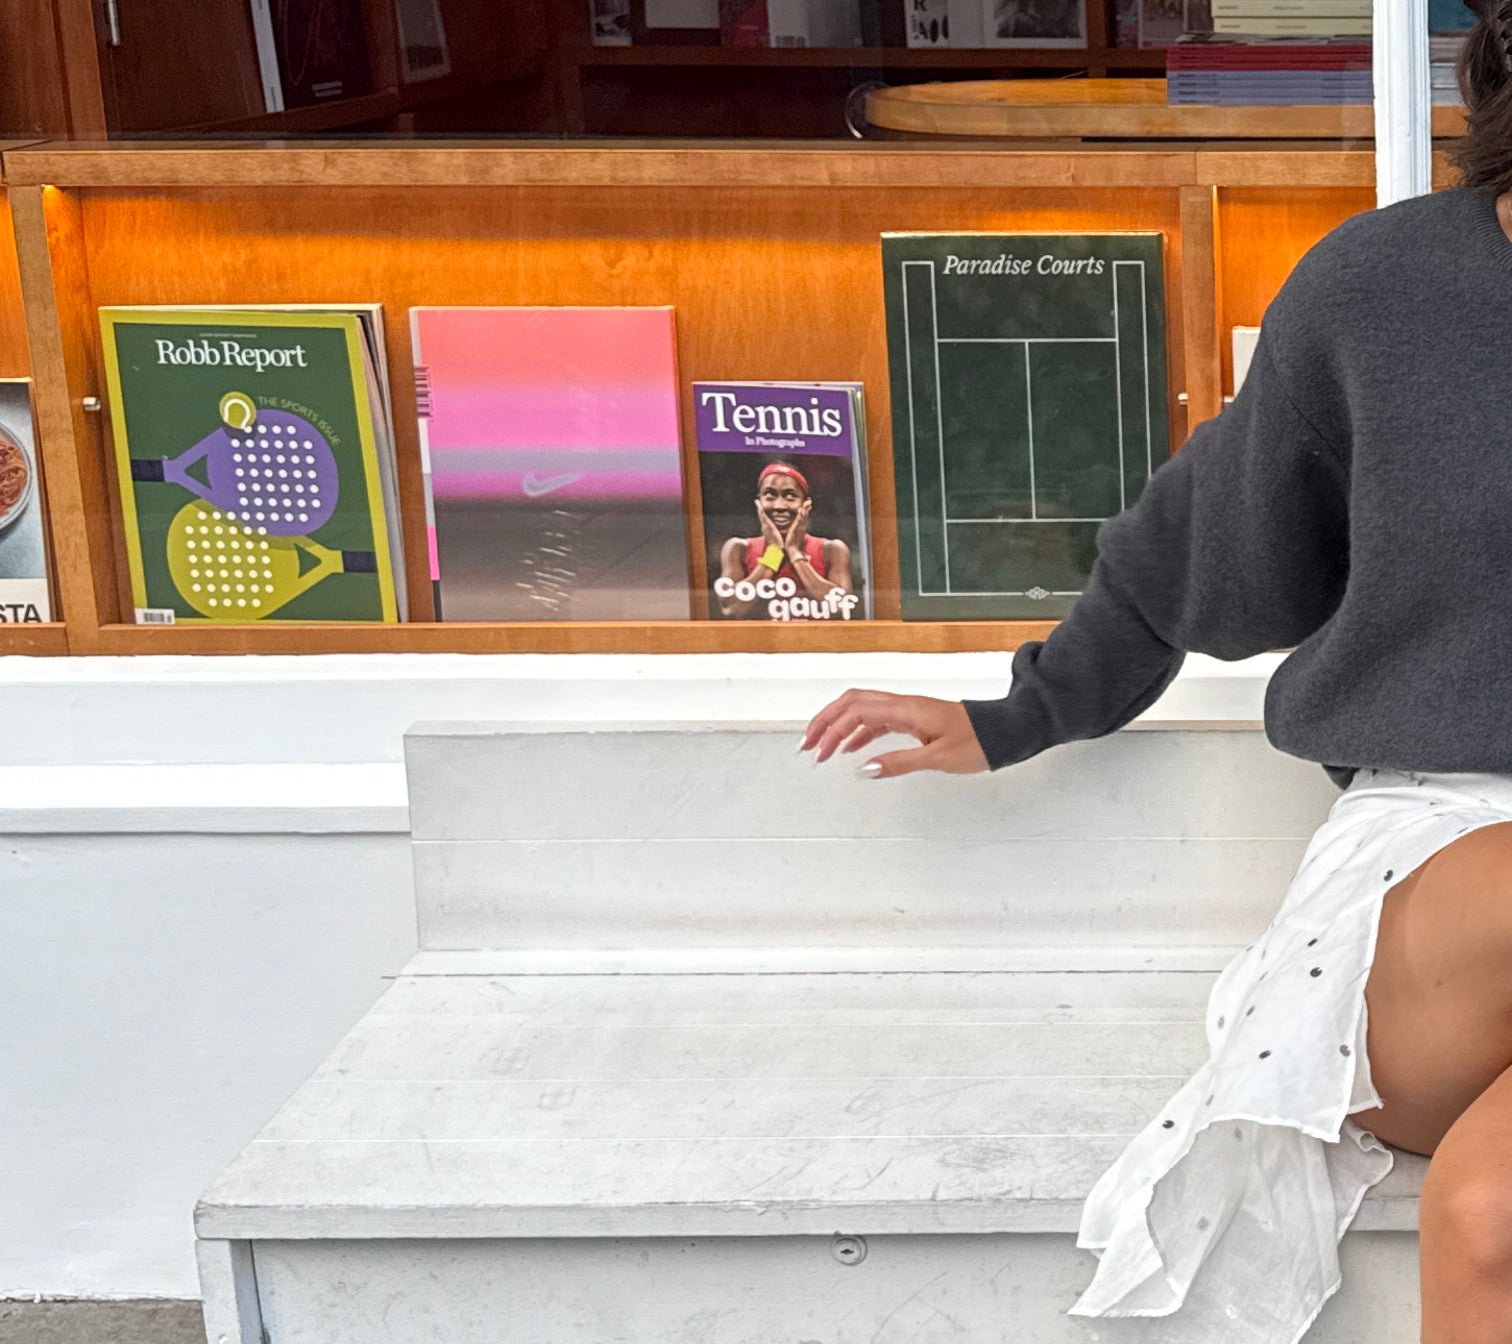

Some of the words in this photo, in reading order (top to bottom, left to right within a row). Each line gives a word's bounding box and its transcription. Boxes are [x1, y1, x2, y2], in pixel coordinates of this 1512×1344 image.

[942, 253, 1033, 275] Paradise
[1037, 254, 1105, 275] Courts
[154, 339, 220, 365] Robb
[221, 341, 308, 372] Report
[258, 396, 278, 407] THE
[281, 398, 318, 422] SPORTS
[318, 419, 342, 446] ISSUE
[702, 392, 843, 437] Tennis
[745, 437, 755, 446] In
[756, 437, 806, 449] Photographs
[713, 577, 797, 601] coco
[767, 586, 859, 621] gauff
